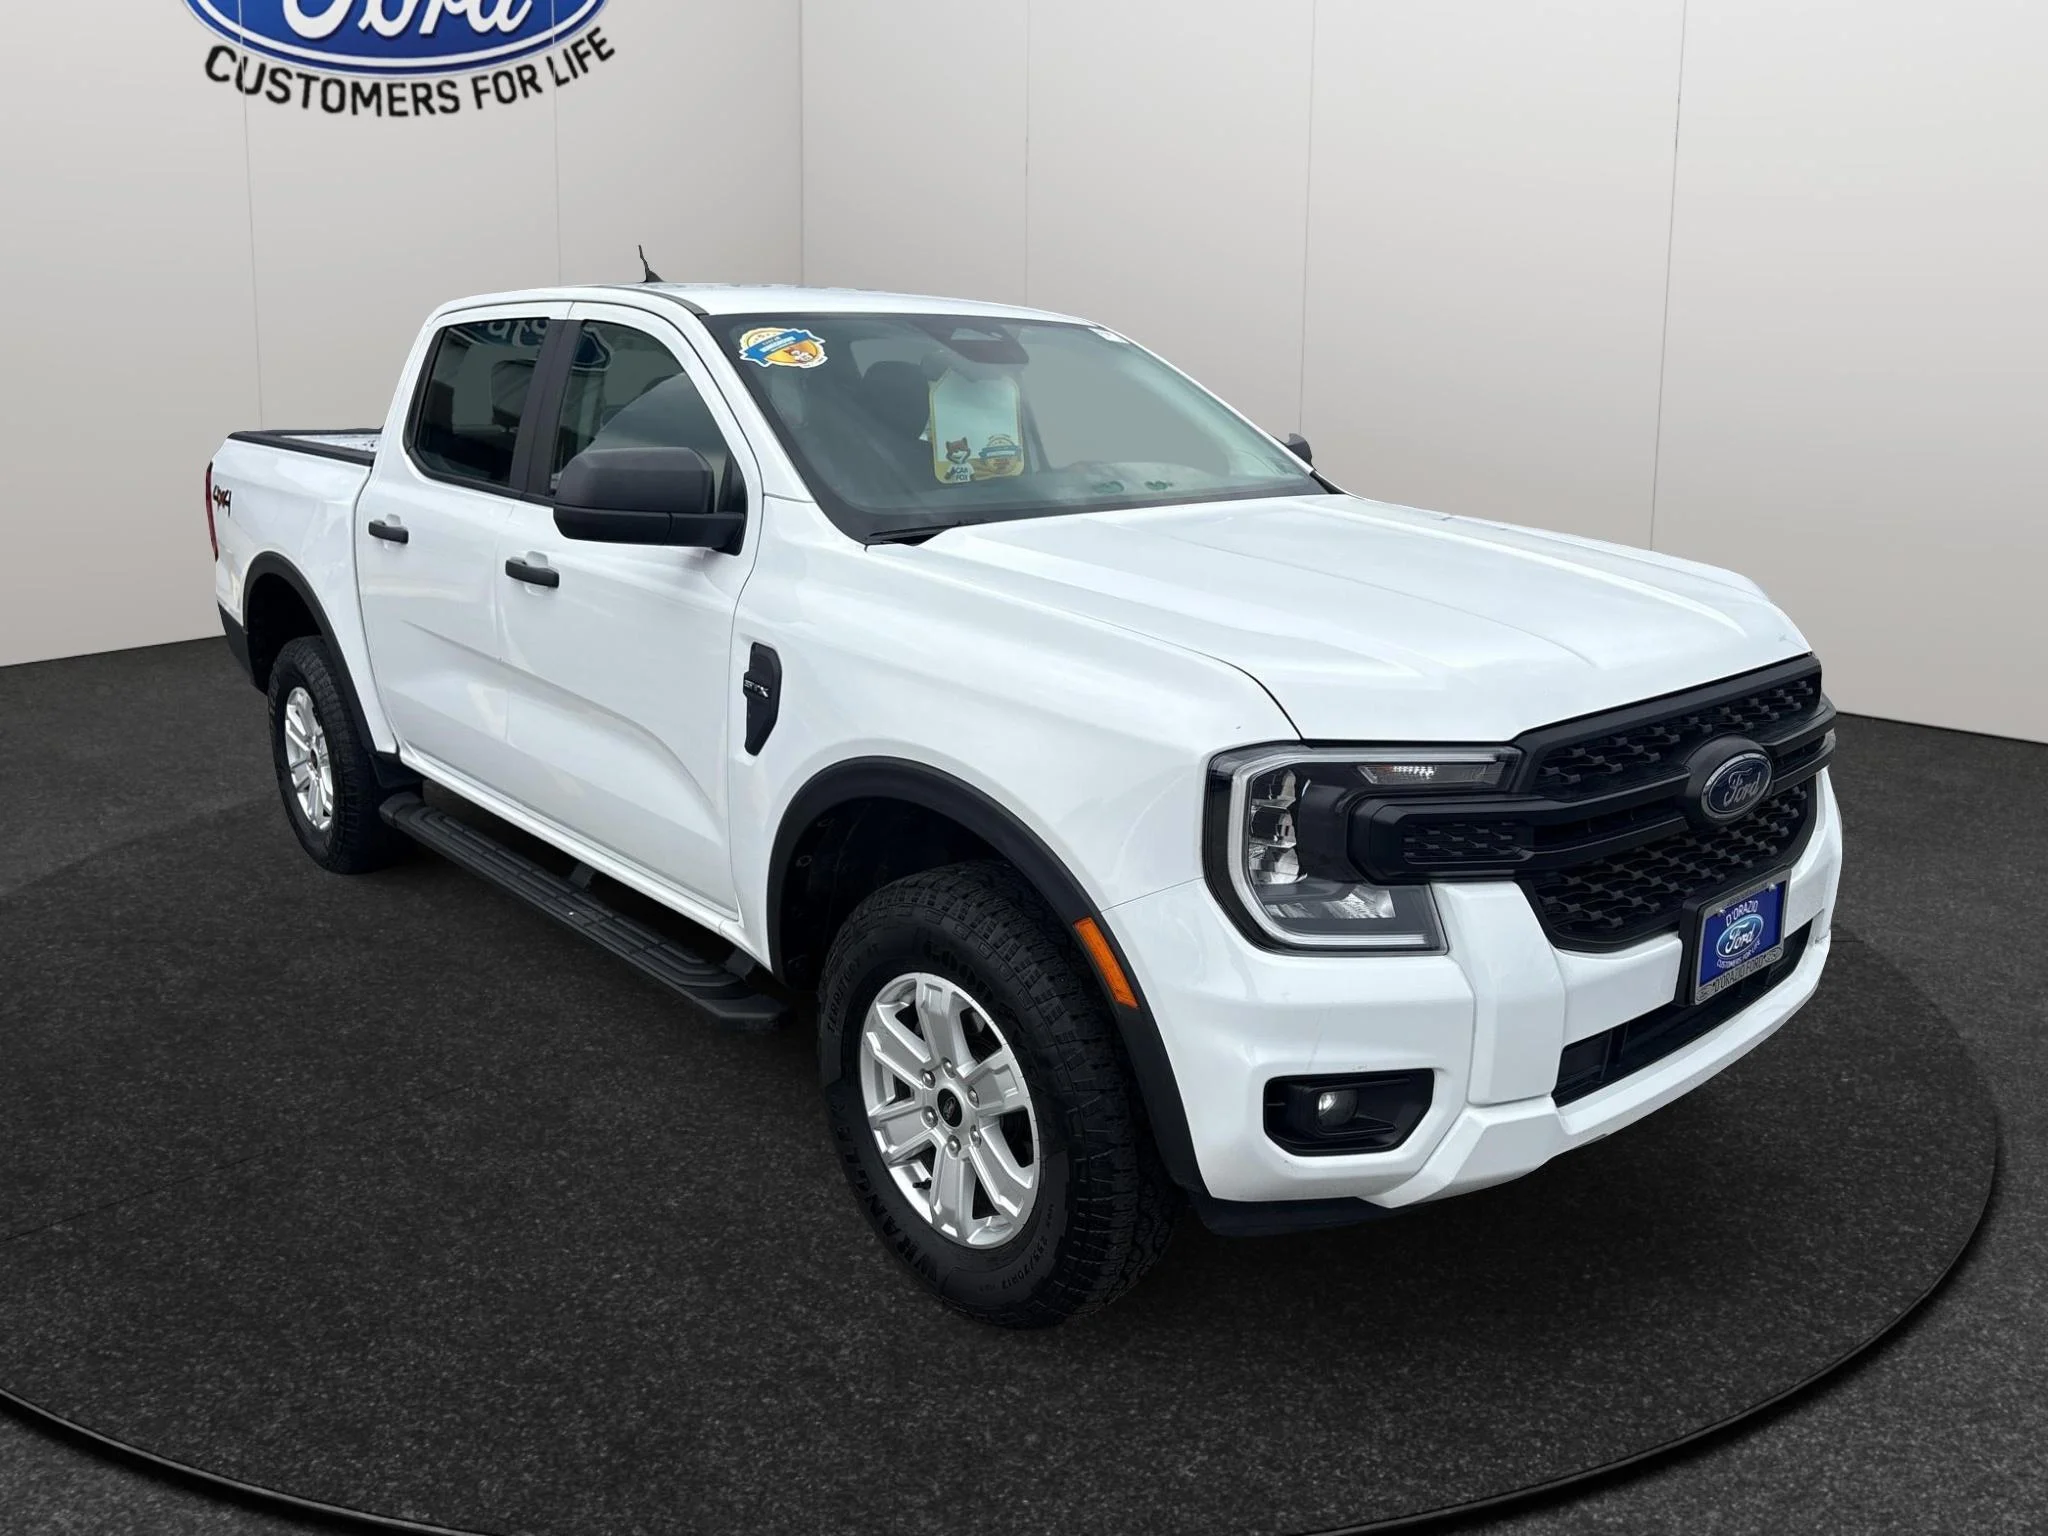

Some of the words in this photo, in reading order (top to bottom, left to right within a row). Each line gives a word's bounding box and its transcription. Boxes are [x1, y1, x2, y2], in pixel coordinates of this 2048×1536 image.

[204, 45, 460, 117] CUSTOMERS
[471, 63, 543, 109] FOR
[546, 26, 616, 88] LIFE
[1723, 767, 1761, 808] Ford
[1725, 900, 1758, 927] D'ORAZIO
[1724, 921, 1757, 954] Ford
